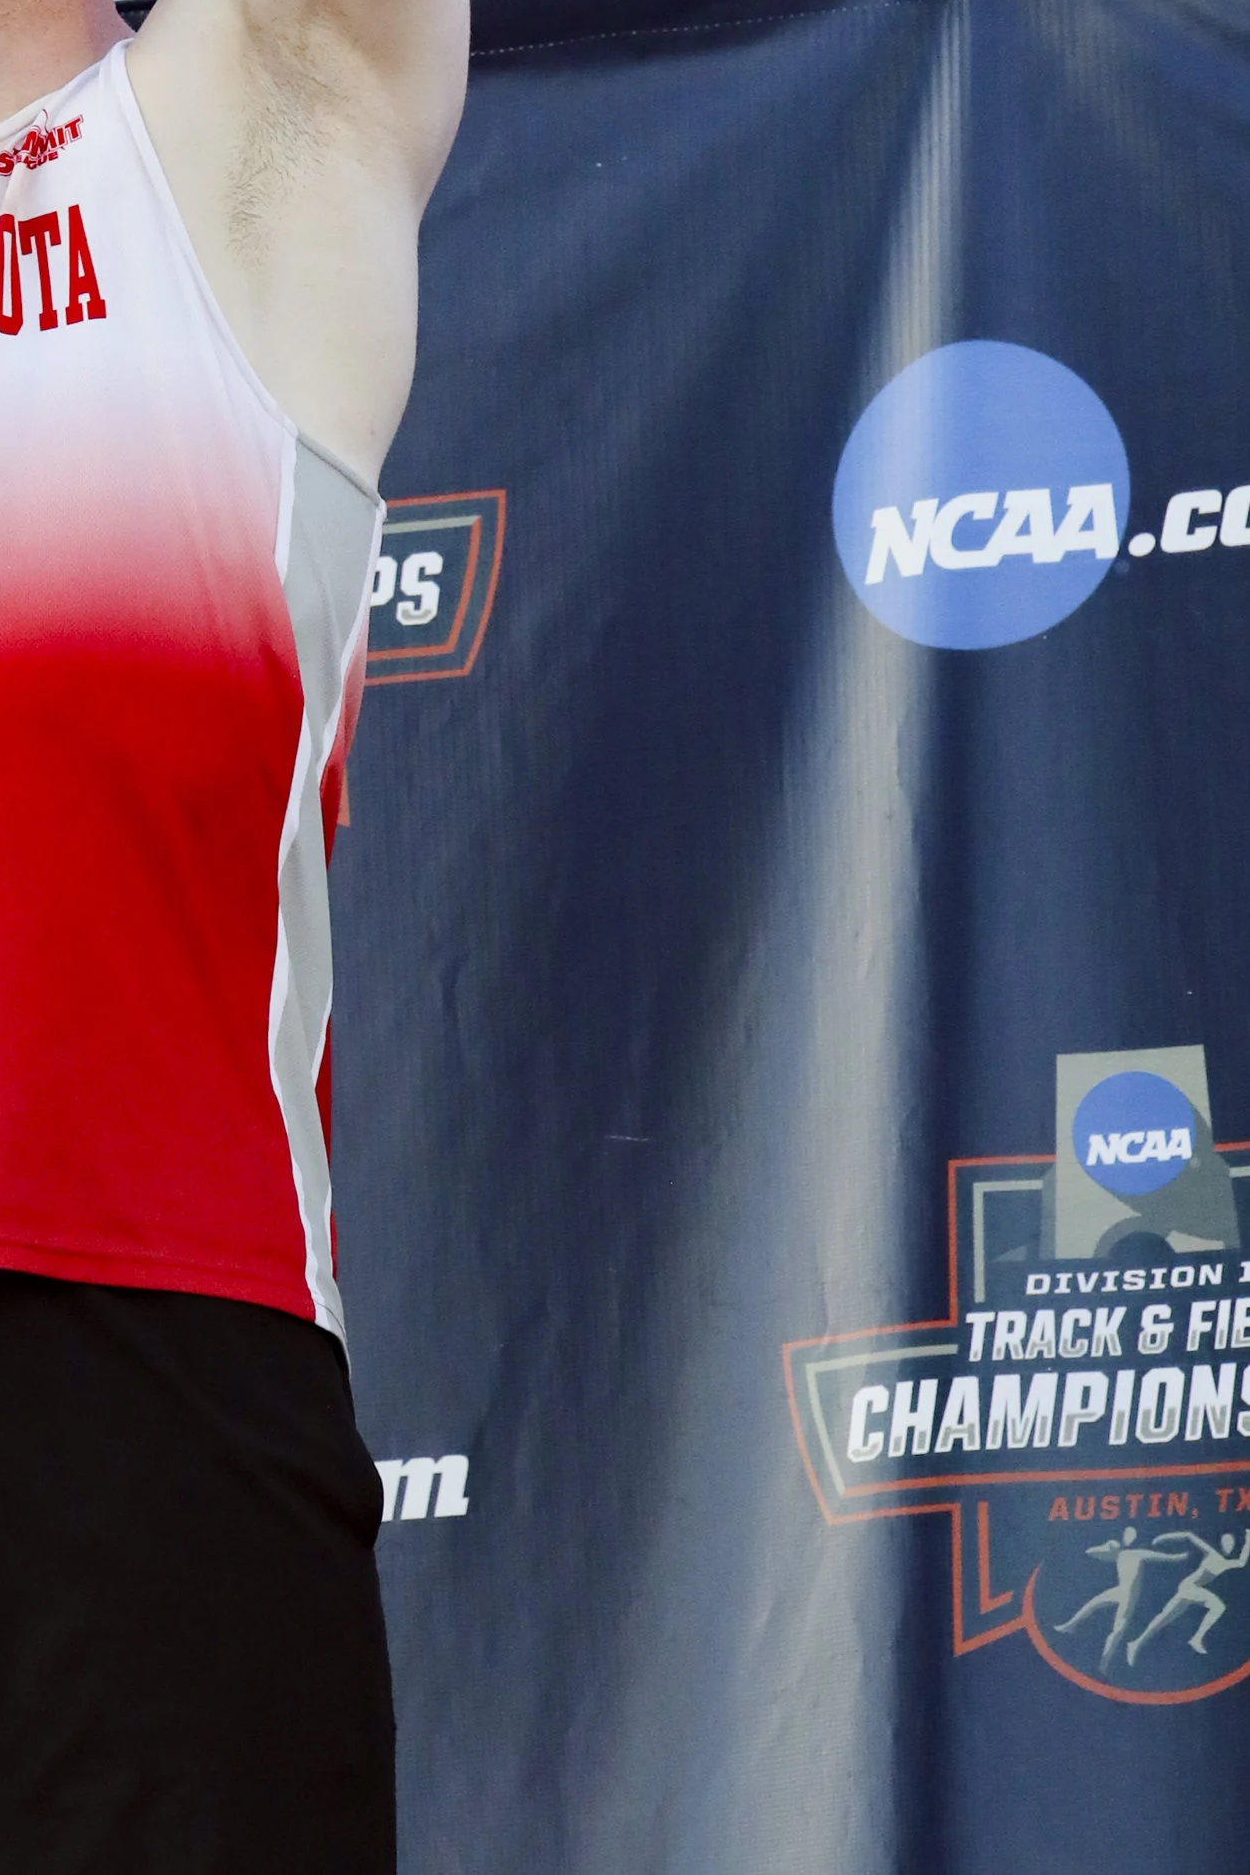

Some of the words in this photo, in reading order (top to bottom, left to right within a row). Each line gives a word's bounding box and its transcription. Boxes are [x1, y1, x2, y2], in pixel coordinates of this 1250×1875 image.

[1085, 1128, 1192, 1167] NCAA
[1026, 1263, 1223, 1295] DIVISION
[964, 1306, 1127, 1362] TRACK
[1137, 1303, 1175, 1355] &
[1049, 1490, 1199, 1521] AUSTIN,
